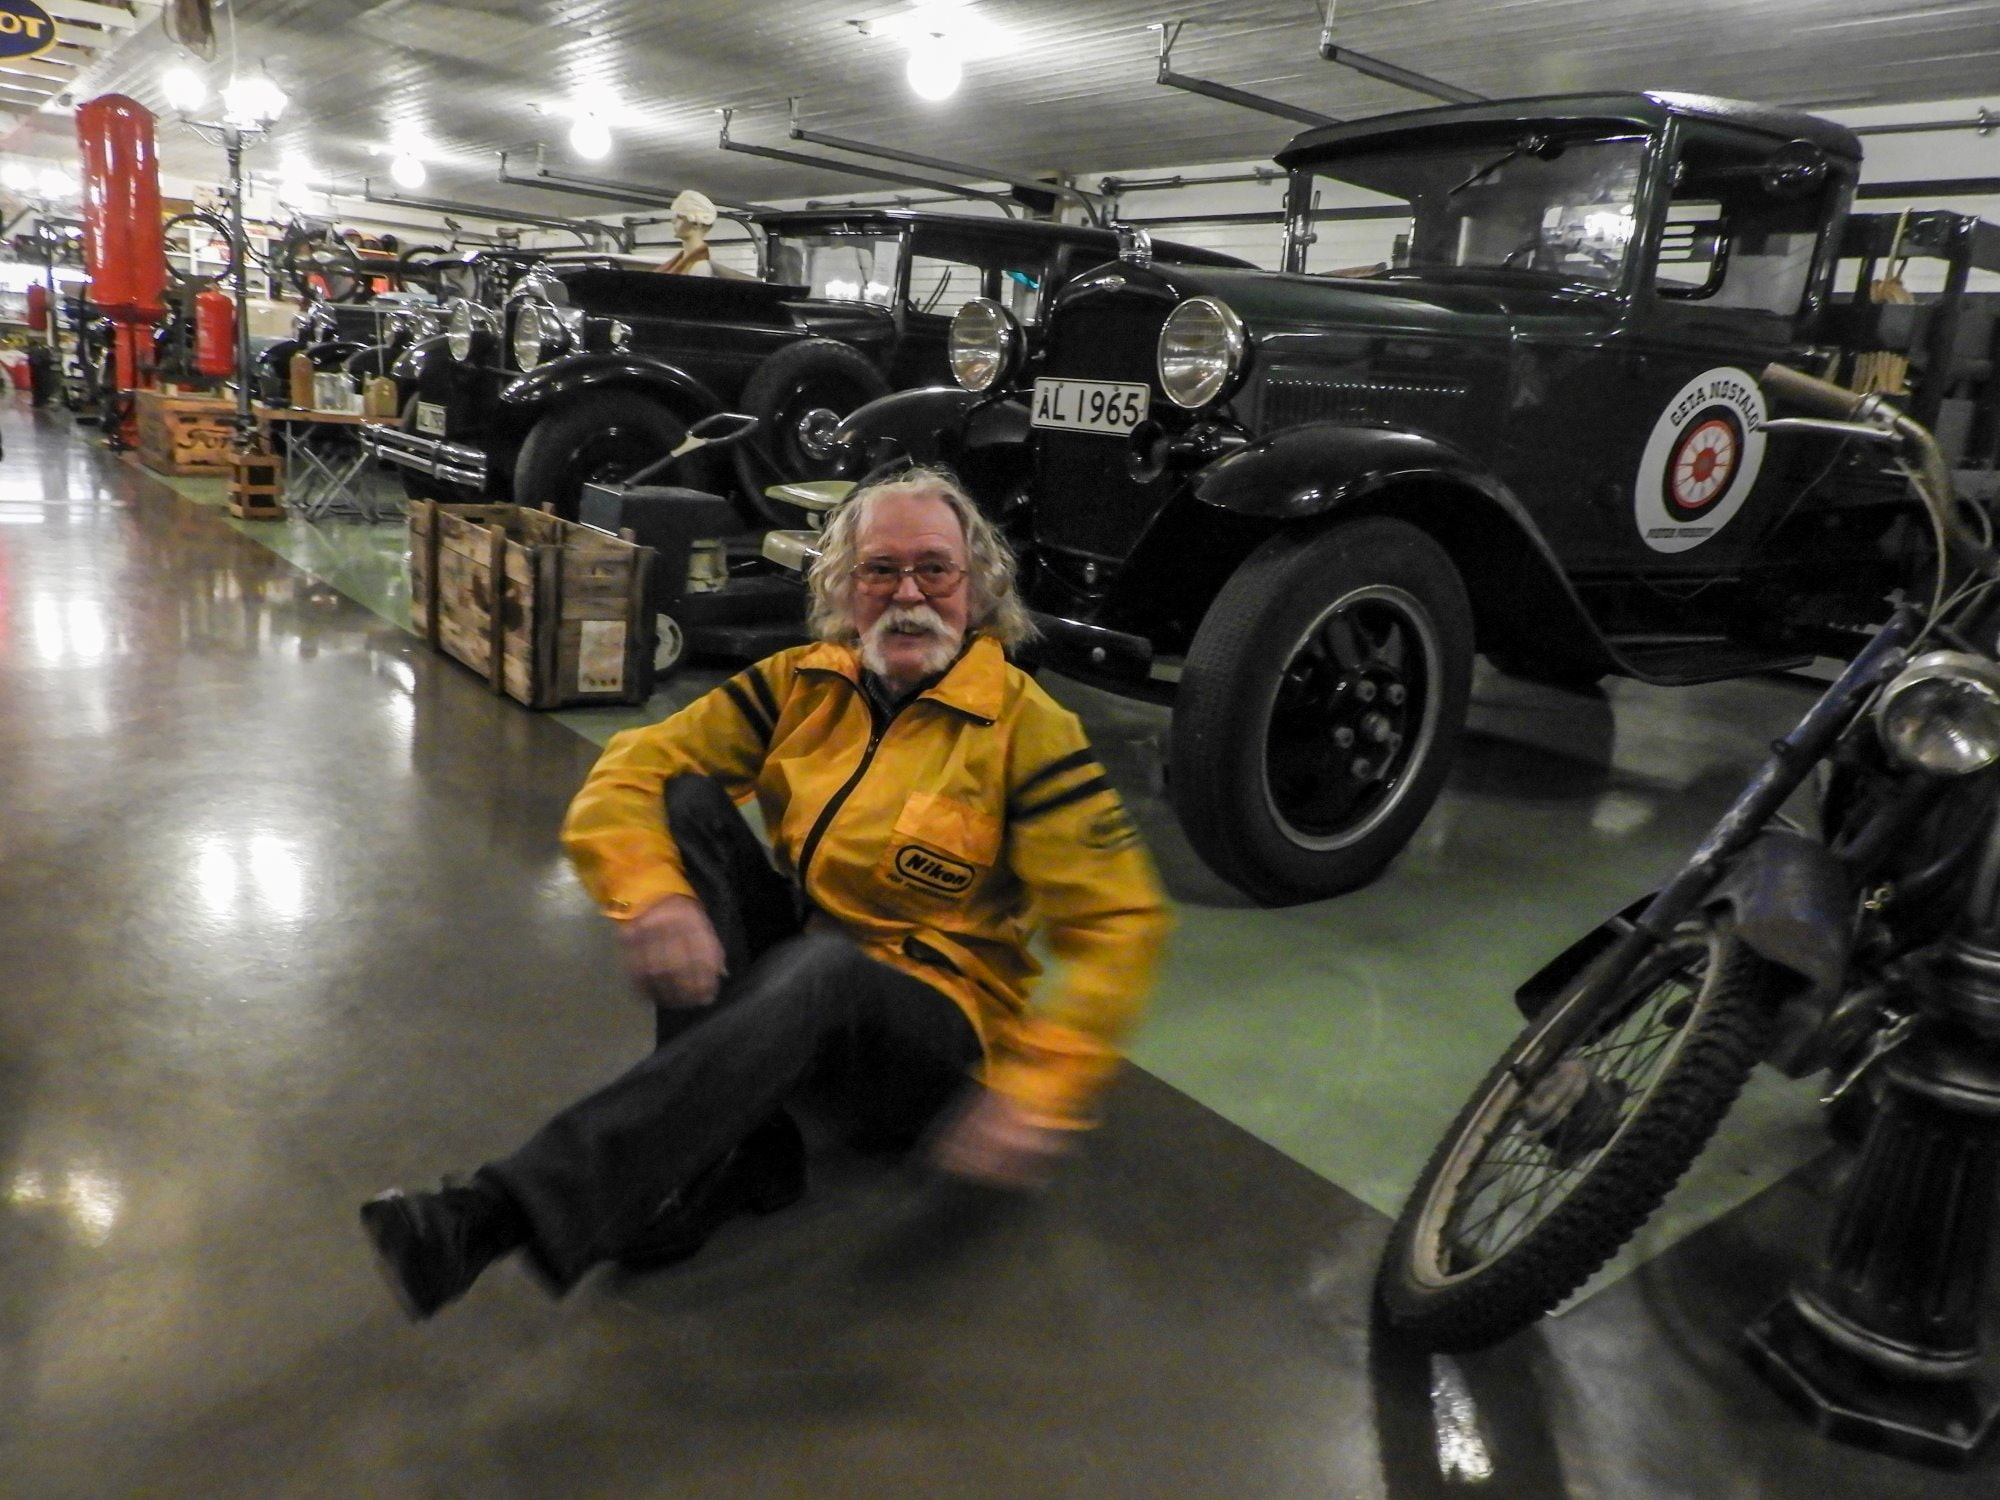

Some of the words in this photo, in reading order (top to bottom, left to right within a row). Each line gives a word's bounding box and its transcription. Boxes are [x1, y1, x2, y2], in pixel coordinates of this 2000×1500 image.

[1077, 388, 1140, 427] 1965
[1669, 387, 1706, 427] GETA
[177, 427, 233, 450] For
[904, 853, 968, 886] Nikon
